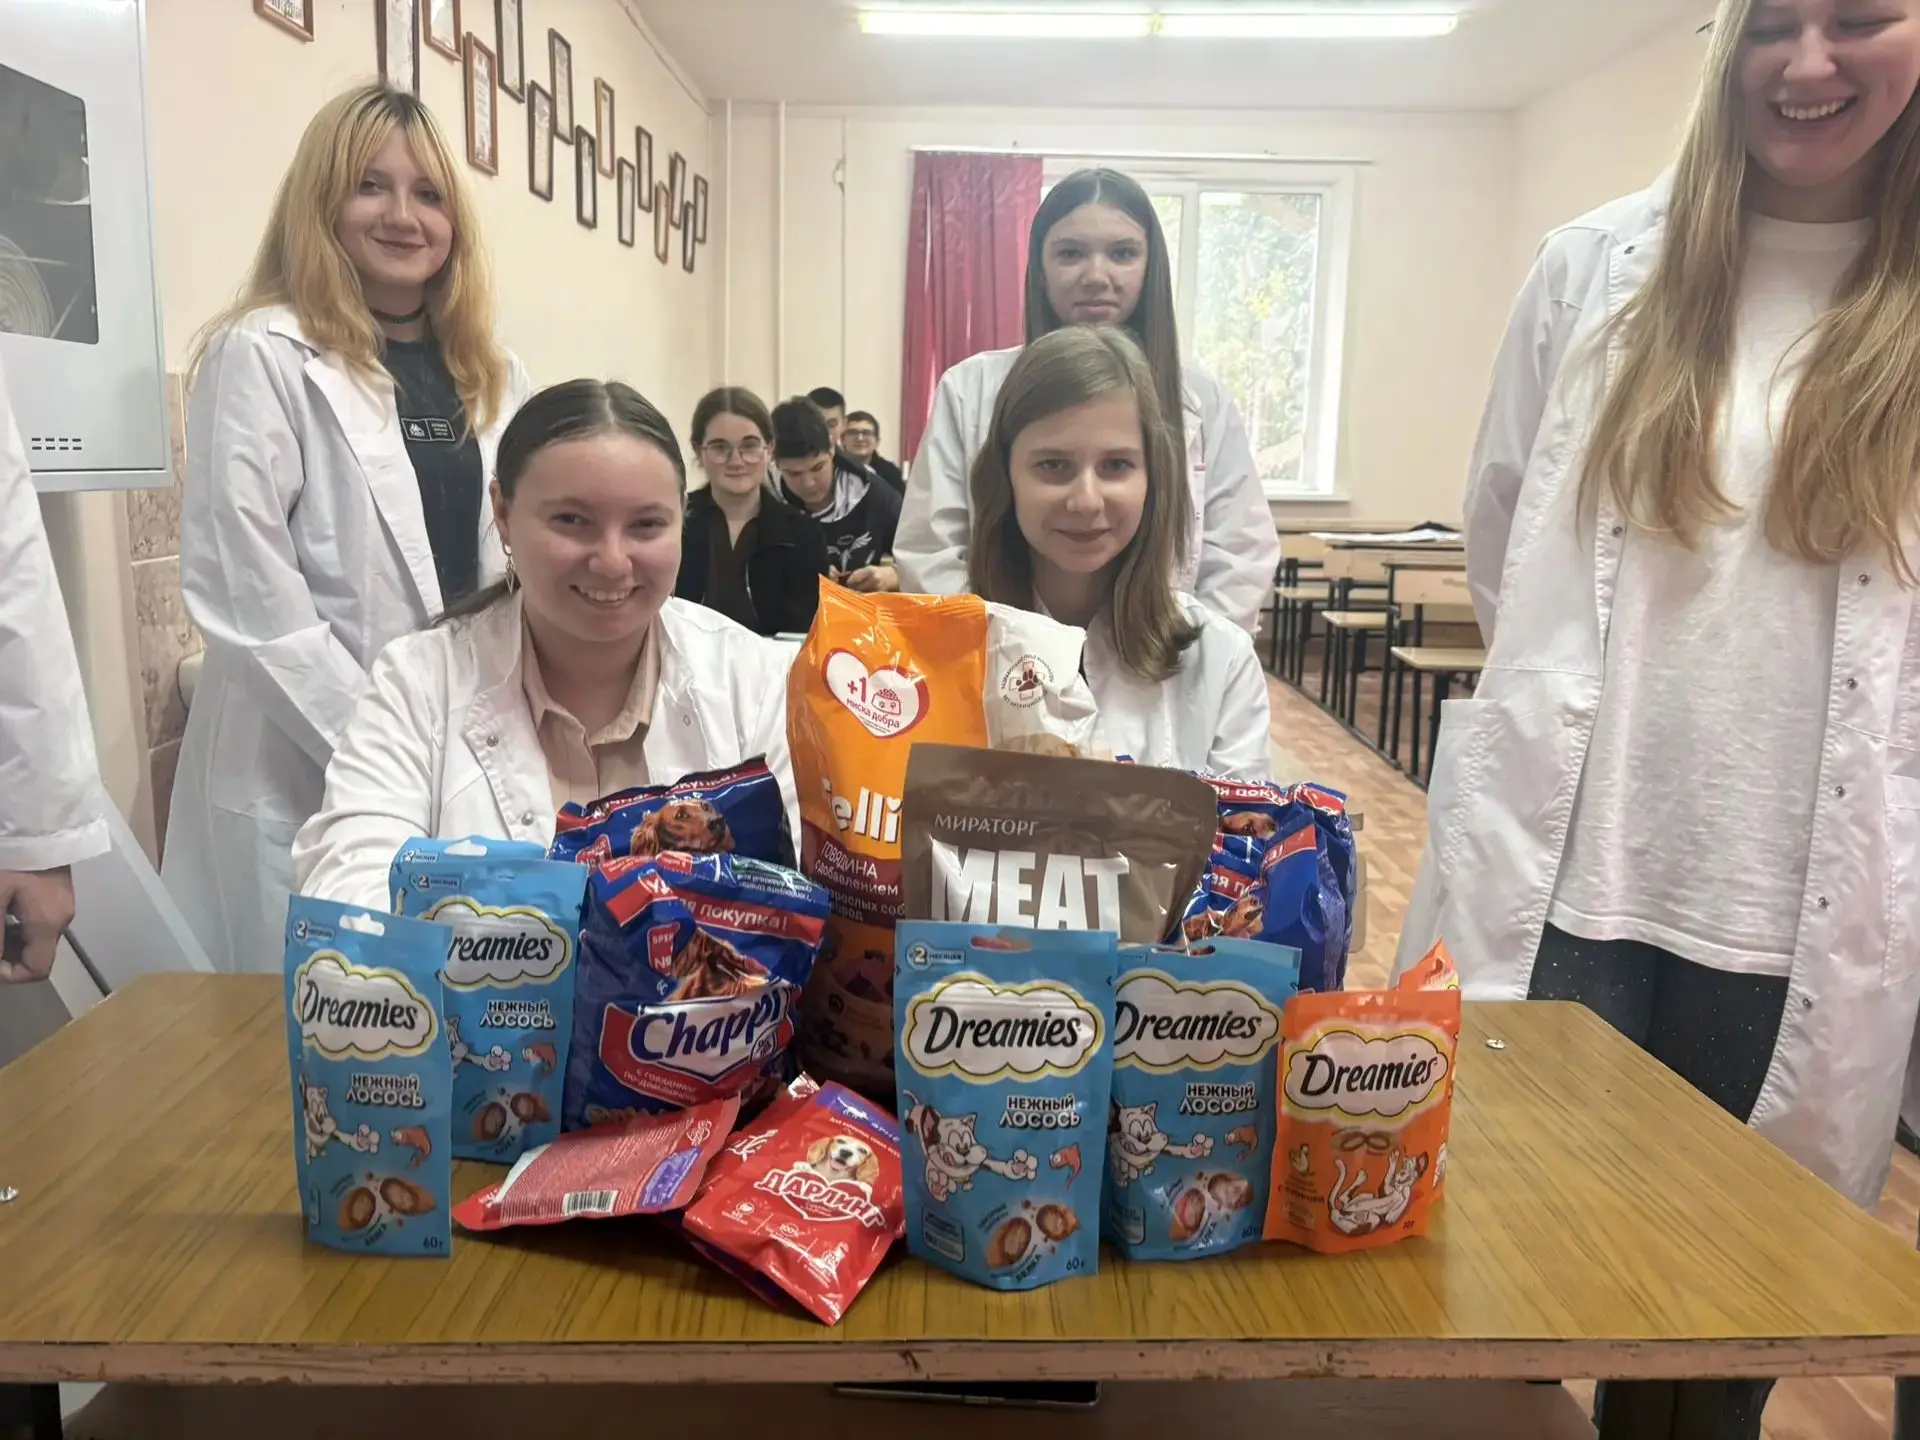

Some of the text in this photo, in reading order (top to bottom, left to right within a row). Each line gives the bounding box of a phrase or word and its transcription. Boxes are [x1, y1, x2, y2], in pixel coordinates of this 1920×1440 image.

[846, 676, 867, 704] +1
[846, 698, 871, 717] миска
[871, 711, 901, 729] добра
[933, 813, 1039, 837] МИРАТОРГ
[821, 840, 878, 879] ГОВЯДИНА
[930, 838, 1130, 939] MEAT
[699, 902, 788, 932] покупка!
[447, 932, 553, 961] reamies
[914, 946, 927, 964] 2
[302, 980, 418, 1031] Dreamies
[488, 1000, 549, 1014] НЕЖНЫЙ
[480, 1012, 555, 1029] ЛОСОСЬ
[923, 1006, 1081, 1054] Dreamies
[1114, 1001, 1262, 1046] Dreamies
[352, 1074, 419, 1090] НЕЖНЫЙ
[1300, 1053, 1438, 1096] Dreamies
[346, 1087, 425, 1108] ЛОСОСЬ
[1007, 1093, 1075, 1111] НЕЖНЫЙ
[1187, 1082, 1254, 1098] НЕЖНЫЙ
[999, 1110, 1082, 1129] ЛОСОСЬ
[1179, 1096, 1258, 1115] ЛОСОСЬ
[754, 1168, 886, 1229] ДАРЛИНГ
